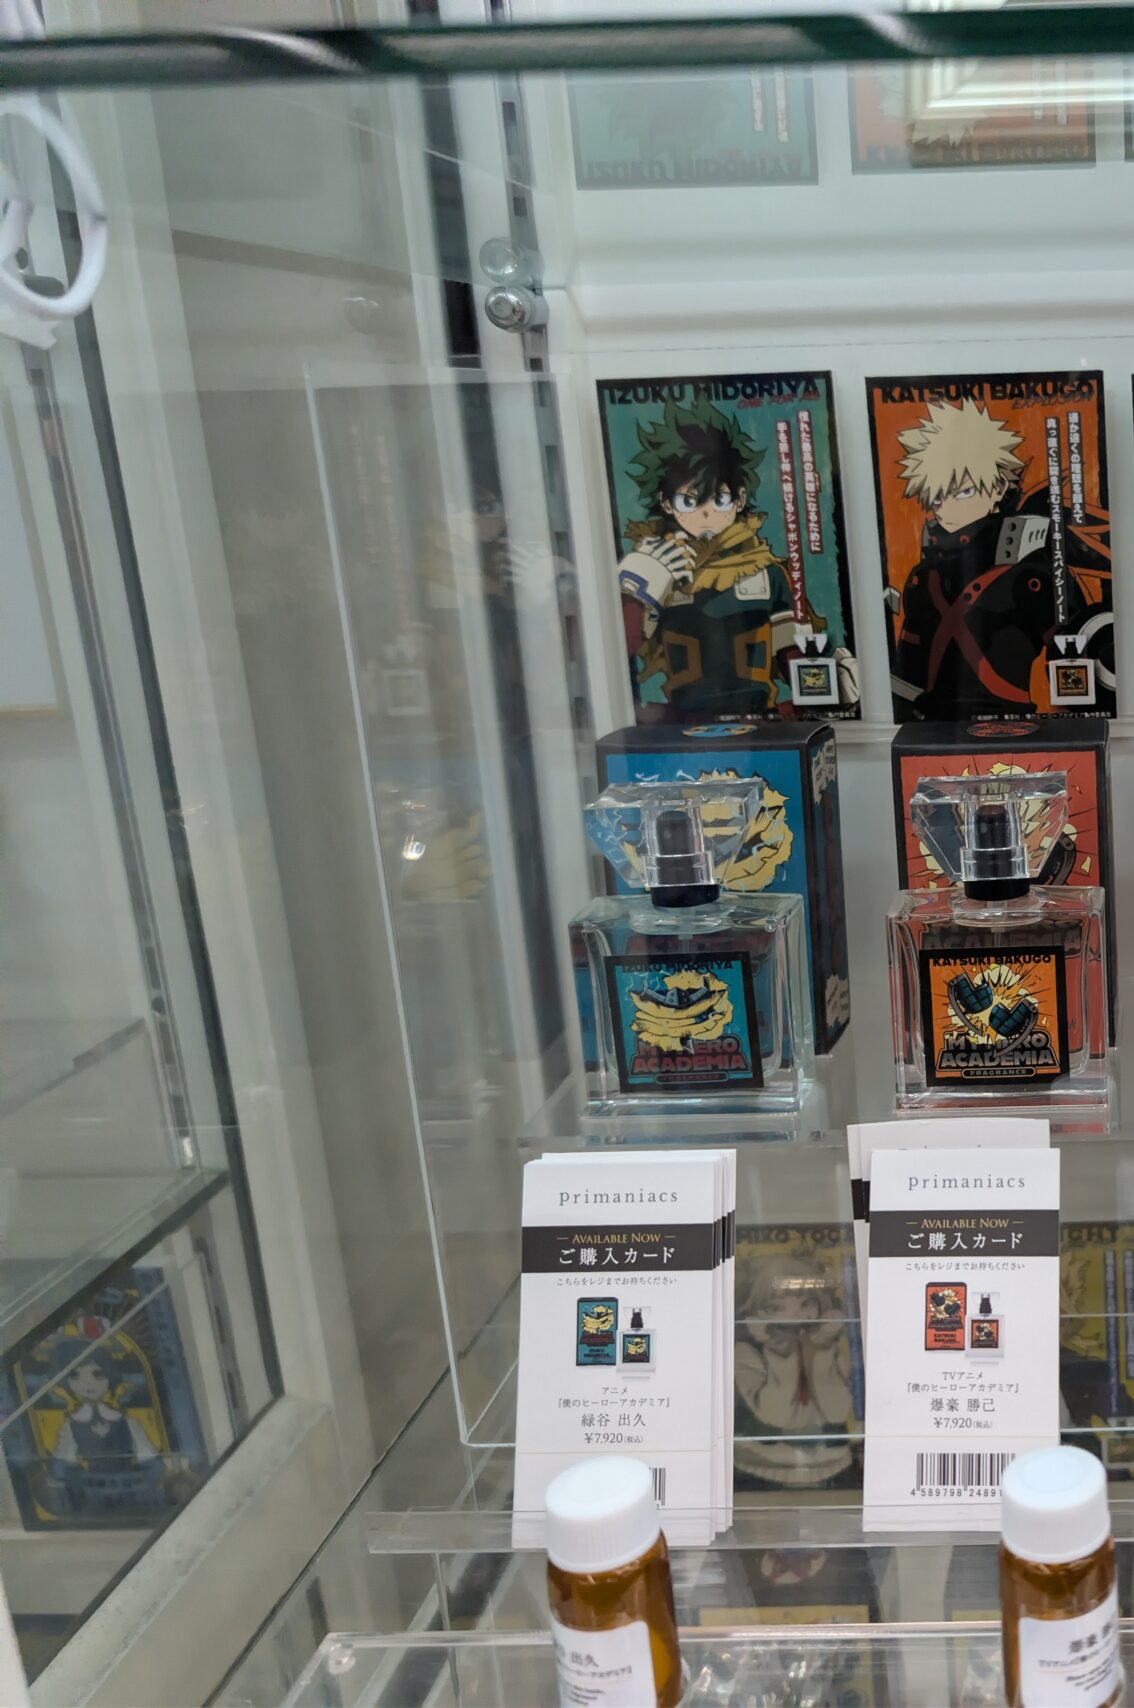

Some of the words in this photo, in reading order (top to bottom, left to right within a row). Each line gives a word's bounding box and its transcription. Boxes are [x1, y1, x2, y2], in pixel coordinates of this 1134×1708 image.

[608, 383, 686, 404] IZUKU
[881, 383, 986, 404] KATSUKI
[990, 379, 1096, 401] BAKUGO
[933, 955, 991, 967] KATSUKI
[995, 954, 1052, 965] BAKUGO
[633, 1054, 746, 1073] ACADEMIA
[940, 1049, 1054, 1067] ACADEMIA
[908, 1173, 1026, 1191] primaniacs
[558, 1188, 679, 1206] primaniacs
[907, 1232, 1024, 1251] ご購入カード
[558, 1247, 676, 1266] ご購入カード
[905, 1261, 1026, 1271] こちらをレジまでお持ちください
[556, 1276, 678, 1286] こちらをレジまでお持ちください
[941, 1371, 984, 1381] TVアニメ
[601, 1386, 628, 1395] アニメ
[930, 1398, 960, 1413] 爆豪
[966, 1398, 996, 1413] 勝己
[581, 1413, 611, 1428] 緑谷
[618, 1412, 647, 1427] 出久
[910, 1488, 916, 1497] 4
[920, 1488, 962, 1497] 589798
